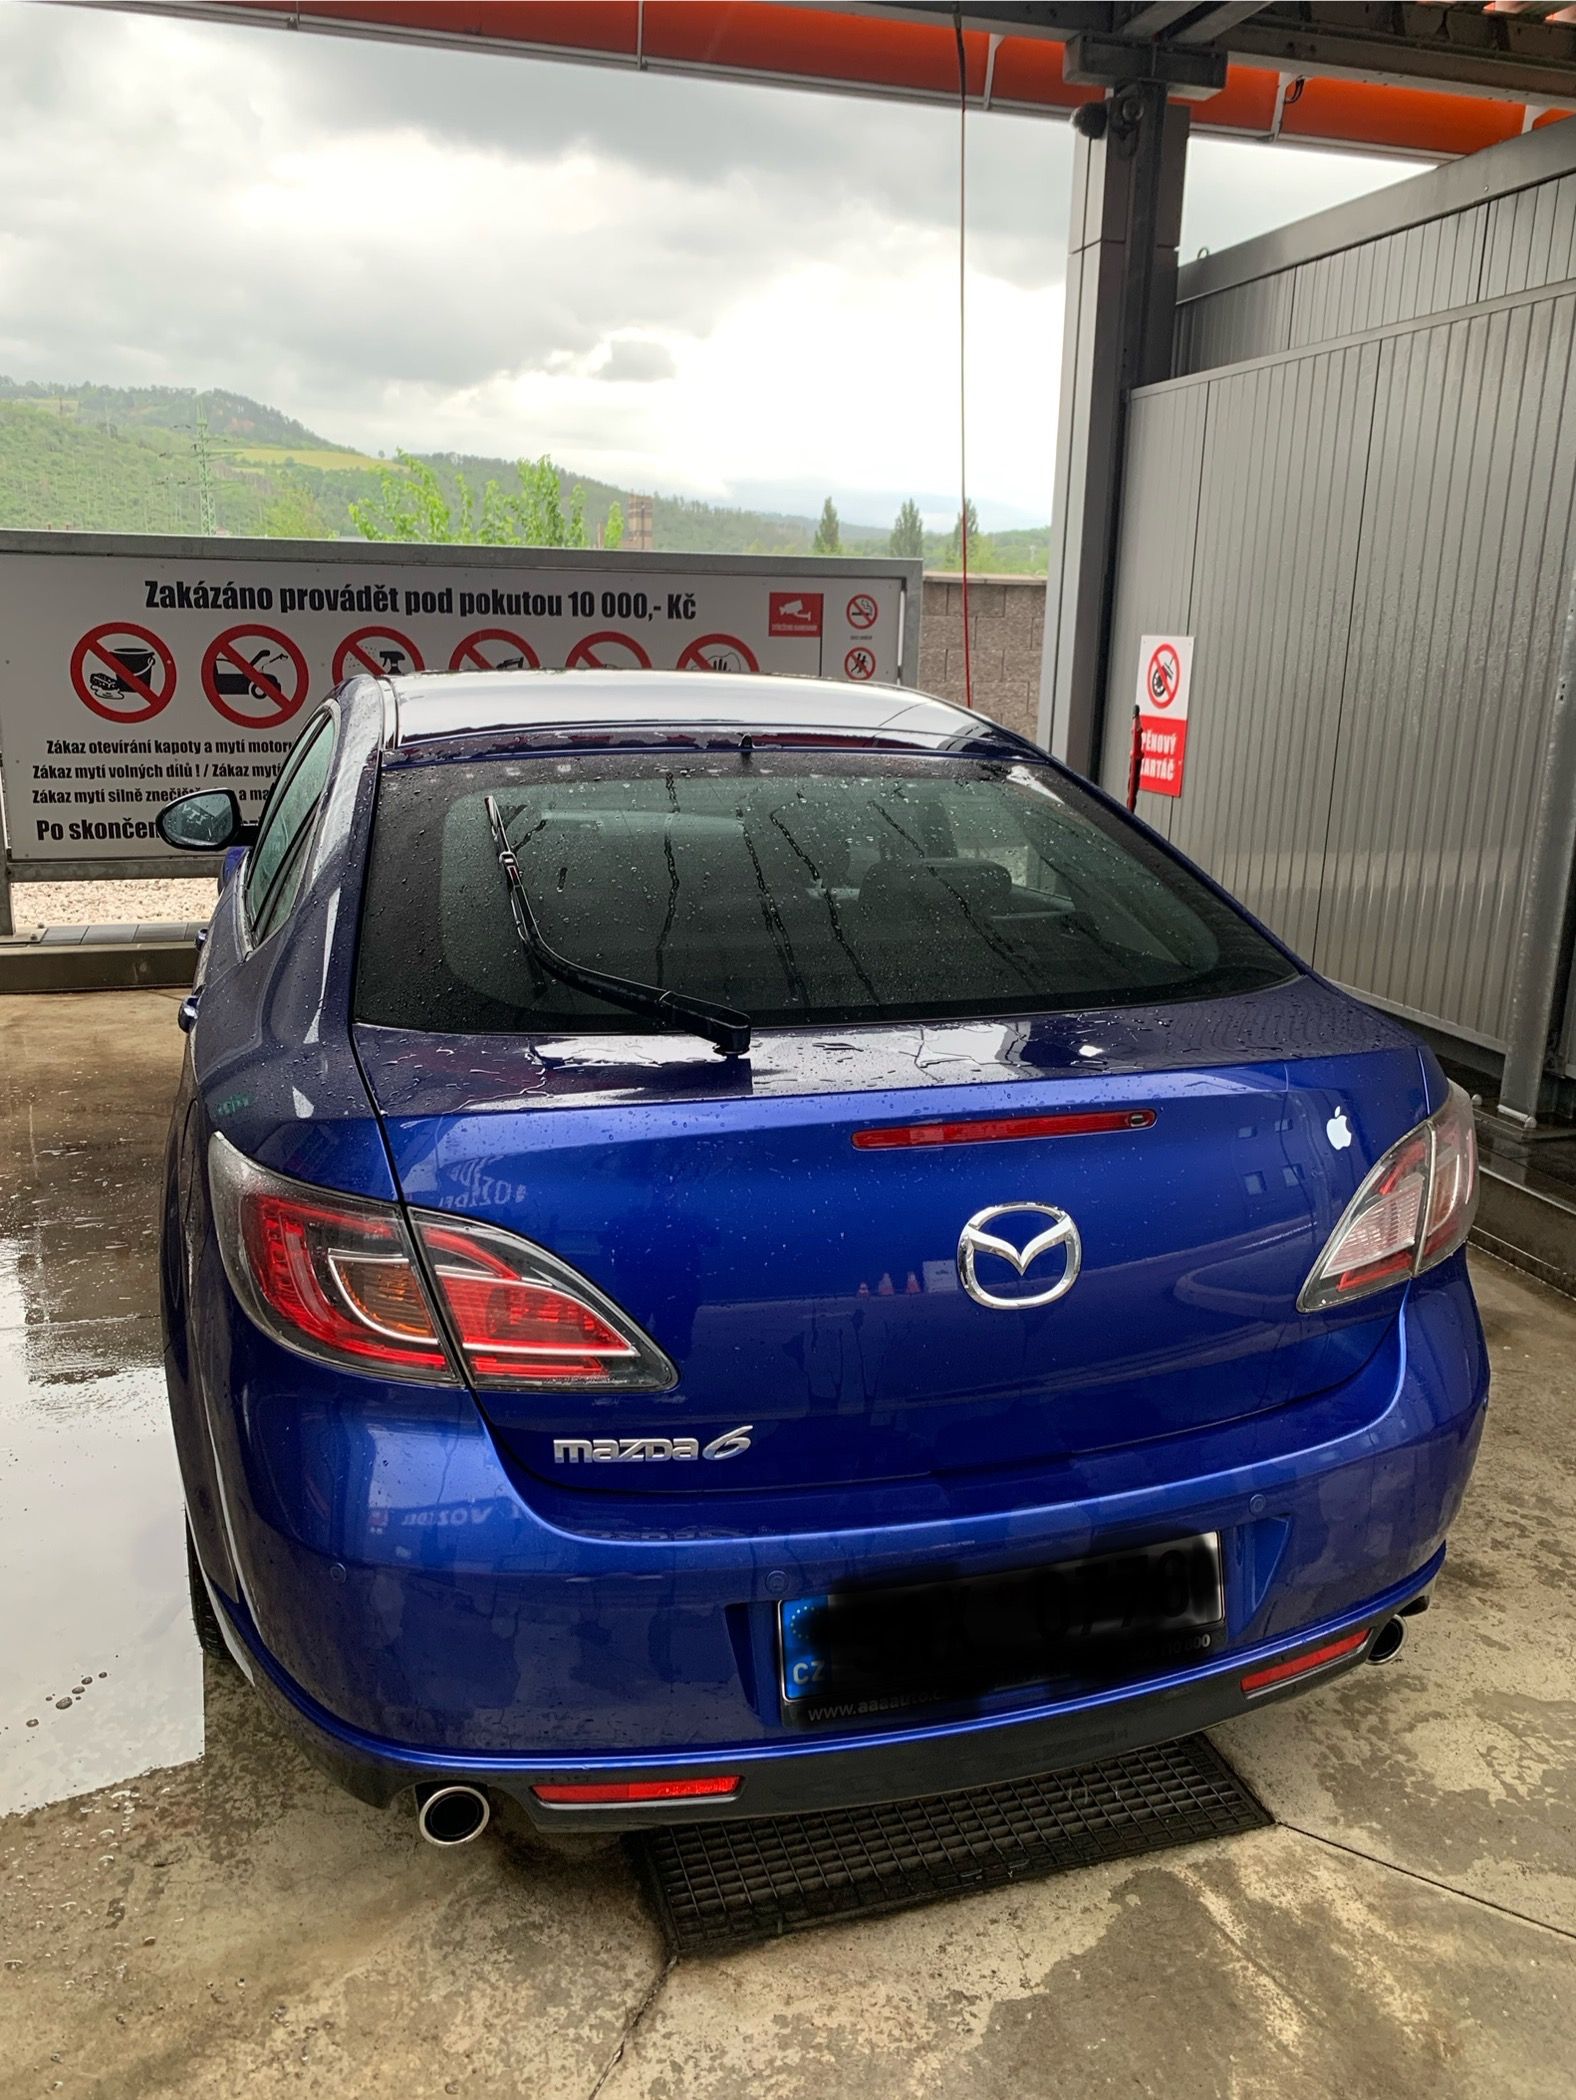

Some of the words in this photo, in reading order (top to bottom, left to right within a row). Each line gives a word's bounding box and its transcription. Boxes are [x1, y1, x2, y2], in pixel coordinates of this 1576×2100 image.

[145, 580, 273, 610] Zakázáno
[279, 583, 399, 613] provádět
[404, 586, 453, 616] pod
[459, 588, 562, 617] pokutou
[567, 590, 595, 617] 10
[601, 591, 662, 621] 000,-
[667, 593, 697, 621] Kč
[47, 739, 86, 754] Zákaz
[88, 738, 151, 754] otevírání
[154, 740, 202, 756] kapoty
[204, 742, 213, 754] a
[215, 739, 246, 755] mytí
[32, 764, 73, 780] Zákaz
[74, 763, 107, 780] mytí
[108, 763, 164, 780] volných
[165, 762, 193, 778] dílů
[211, 762, 250, 778] Zákaz
[31, 788, 73, 804] Zákaz
[74, 787, 106, 805] mytí
[108, 787, 143, 803] silně
[238, 789, 248, 801] a
[36, 819, 64, 841] Po
[793, 1660, 825, 1684] CZ
